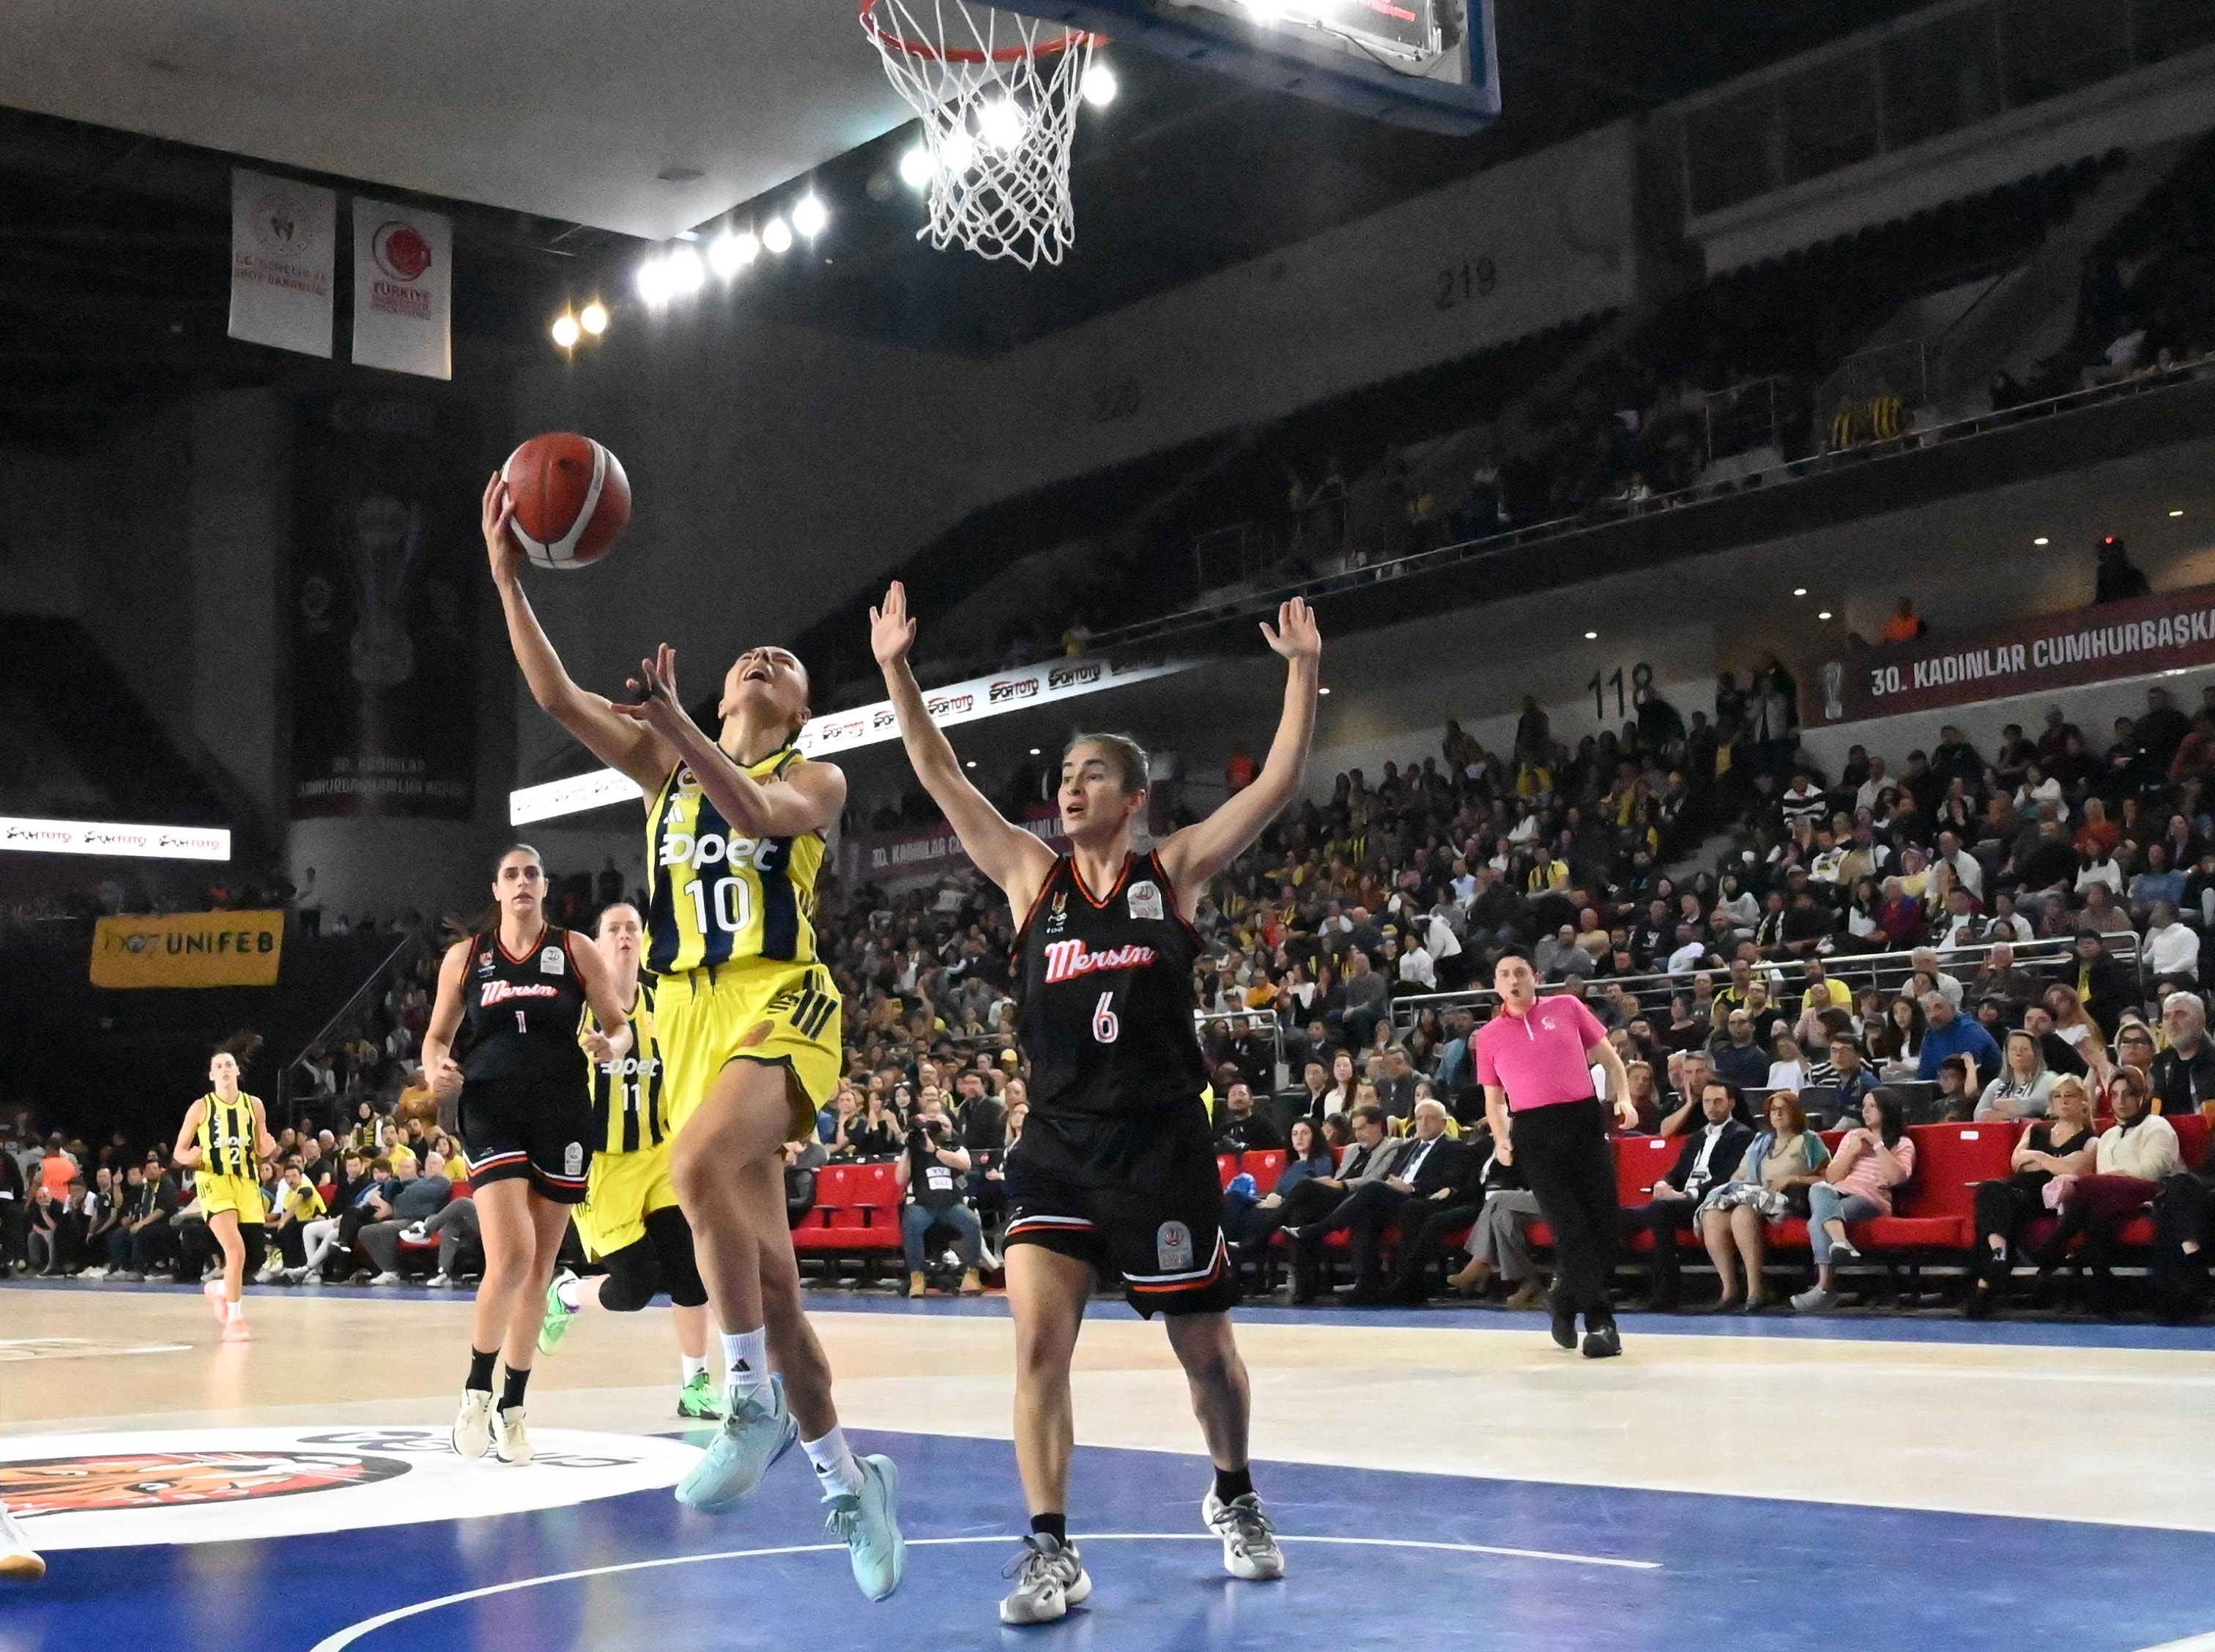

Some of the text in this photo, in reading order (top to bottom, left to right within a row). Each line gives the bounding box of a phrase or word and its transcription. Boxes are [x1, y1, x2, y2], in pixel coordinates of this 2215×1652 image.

[1436, 257, 1497, 309] 219
[1587, 662, 1653, 720] 118
[1871, 666, 1907, 696] 30.
[1913, 644, 2027, 688] KADINLAR
[660, 833, 778, 871] opet
[684, 877, 751, 934] 10
[1045, 939, 1157, 983] Mersin
[481, 980, 558, 1007] Mersin
[515, 1011, 527, 1033] 1
[1092, 991, 1119, 1043] 6
[620, 1082, 641, 1112] 11
[229, 1147, 241, 1165] 2
